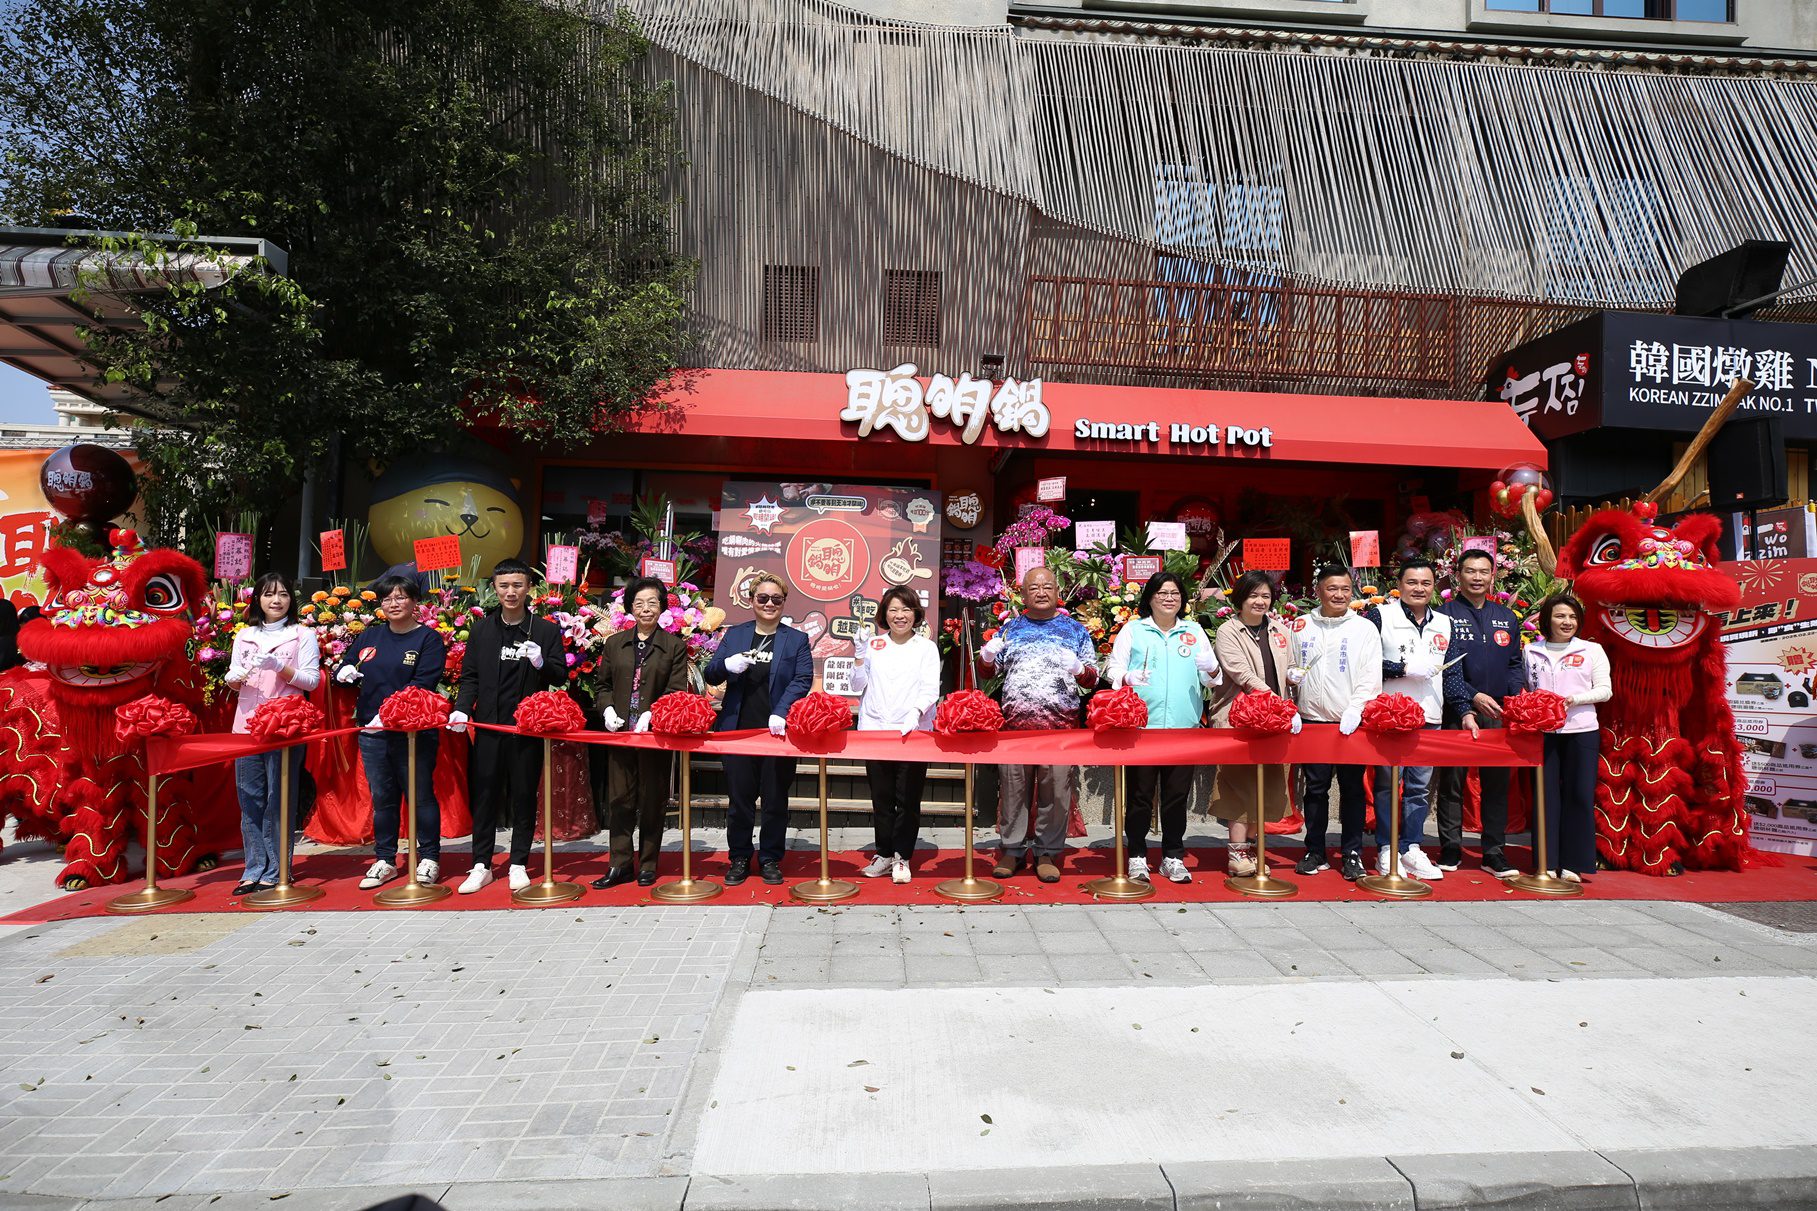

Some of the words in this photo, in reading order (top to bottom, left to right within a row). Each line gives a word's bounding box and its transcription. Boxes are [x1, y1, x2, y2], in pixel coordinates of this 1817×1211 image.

[840, 362, 1051, 445] 聰明鍋
[1629, 387, 1689, 406] KOREAN
[1692, 391, 1757, 411] ZZIMAK
[1760, 396, 1794, 412] NO.1
[1075, 418, 1160, 443] Smart
[1170, 423, 1220, 445] Hot
[1227, 425, 1273, 448] Pot
